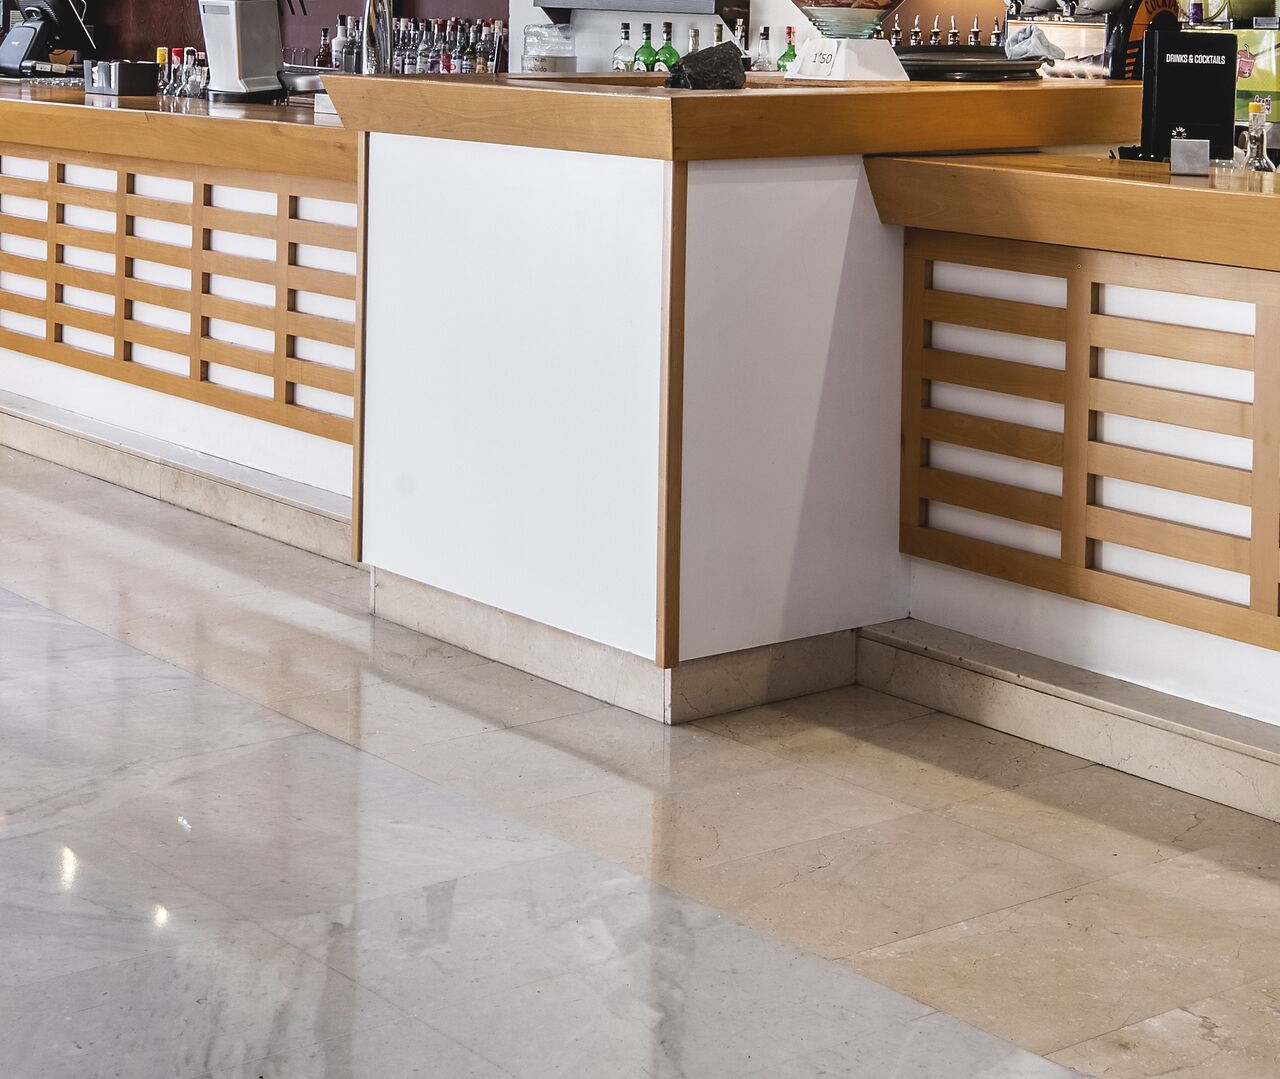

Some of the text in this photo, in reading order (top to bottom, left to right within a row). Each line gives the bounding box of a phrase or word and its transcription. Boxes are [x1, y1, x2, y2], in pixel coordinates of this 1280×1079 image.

[1166, 53, 1226, 65] DRINKS & COCKTAILS
